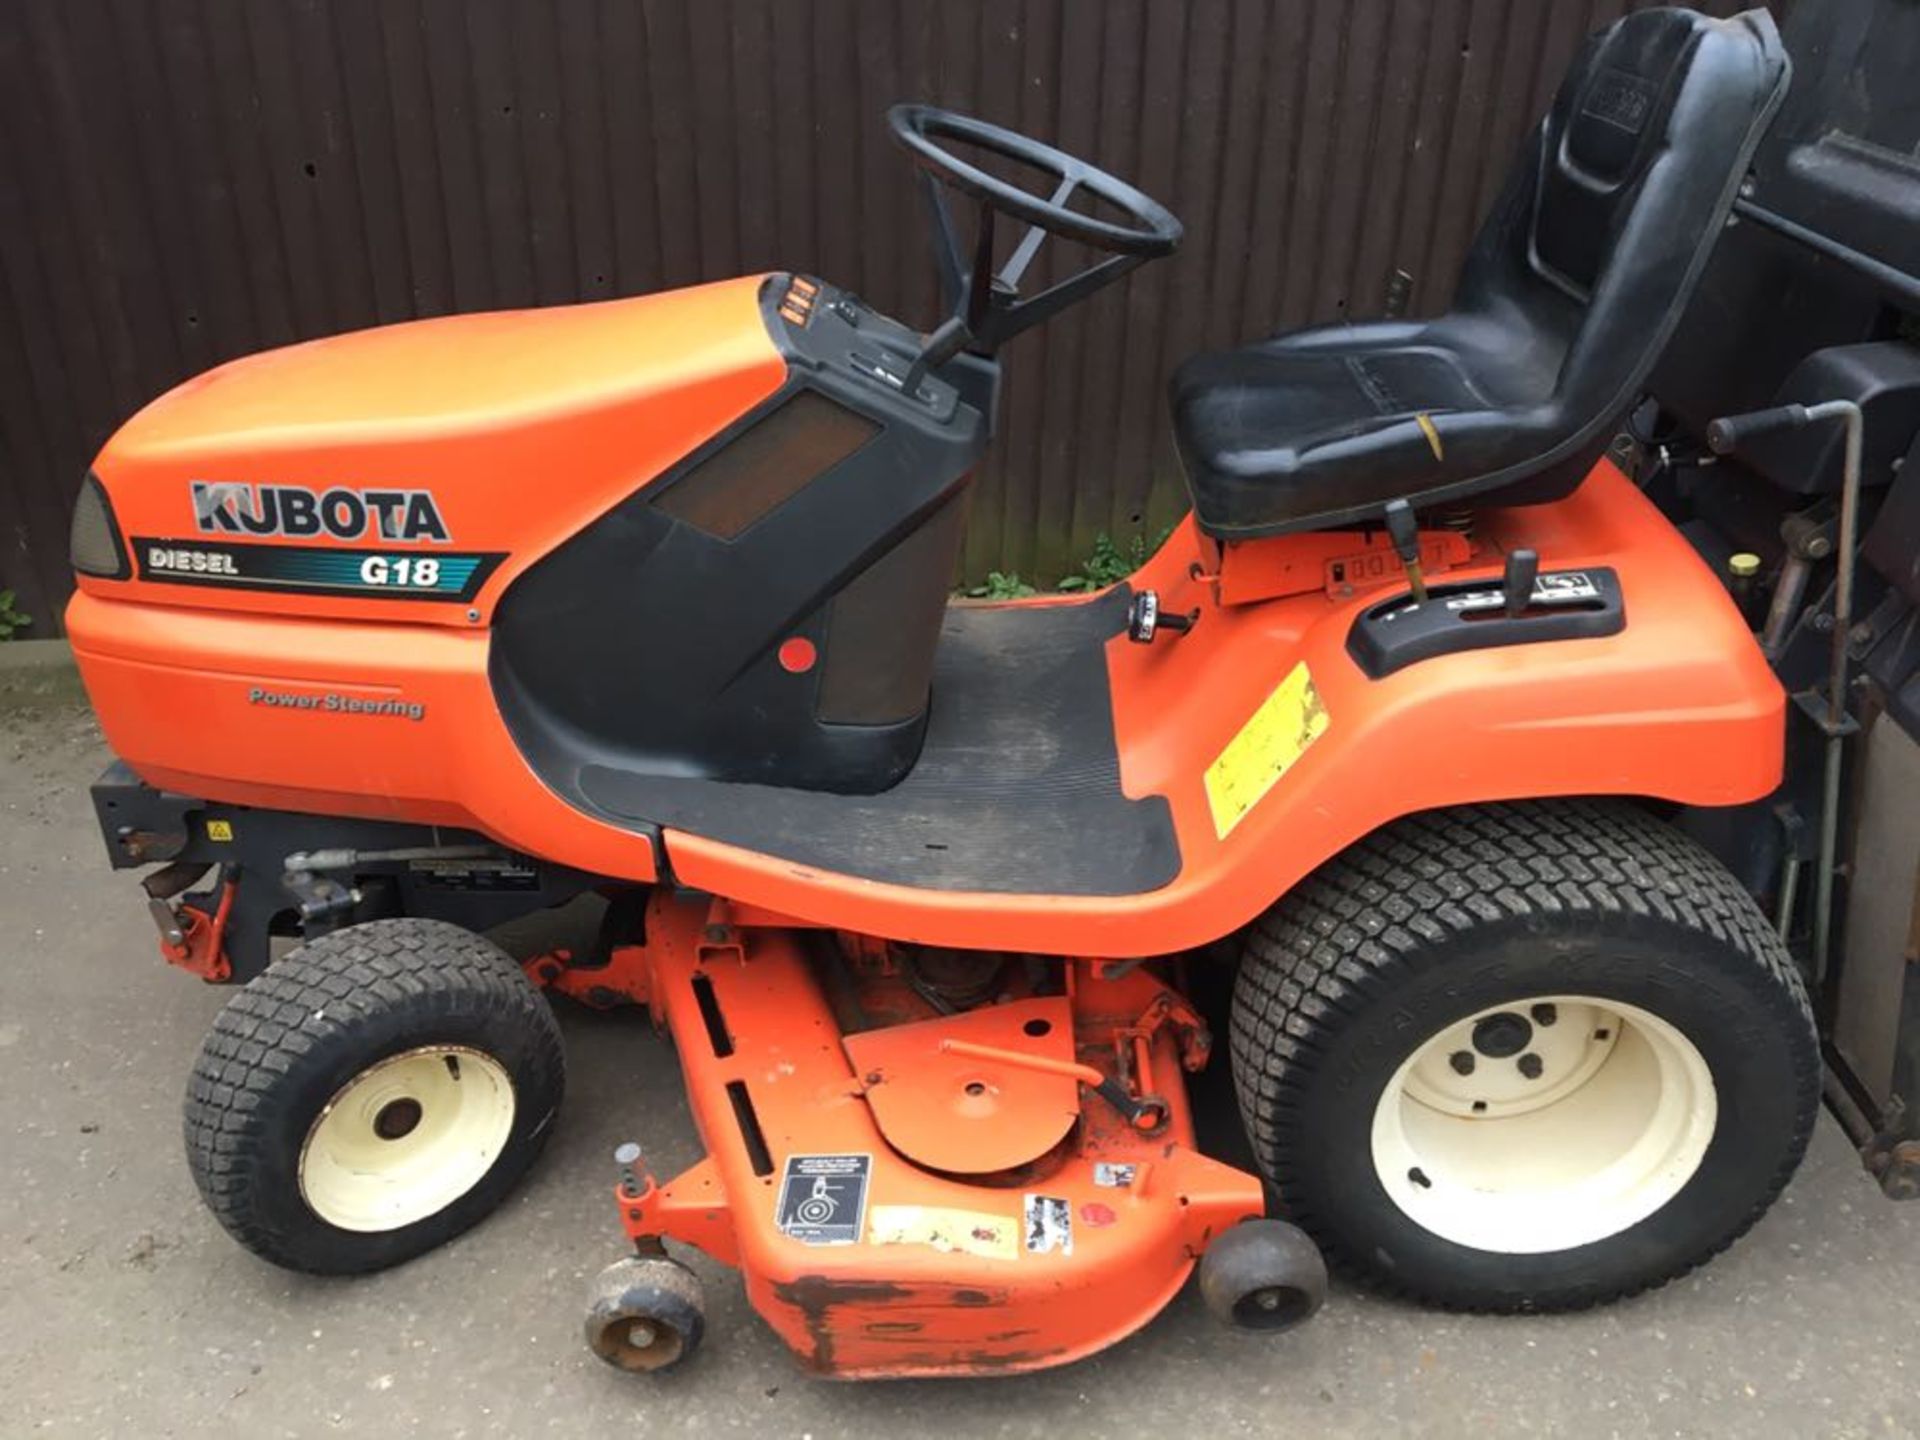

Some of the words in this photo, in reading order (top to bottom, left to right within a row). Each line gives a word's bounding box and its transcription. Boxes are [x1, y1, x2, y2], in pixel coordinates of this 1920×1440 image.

[192, 481, 450, 542] KUBOTA
[149, 548, 238, 574] DIESEL
[360, 556, 440, 585] G18
[249, 687, 322, 709] Power
[326, 693, 424, 720] Steering
